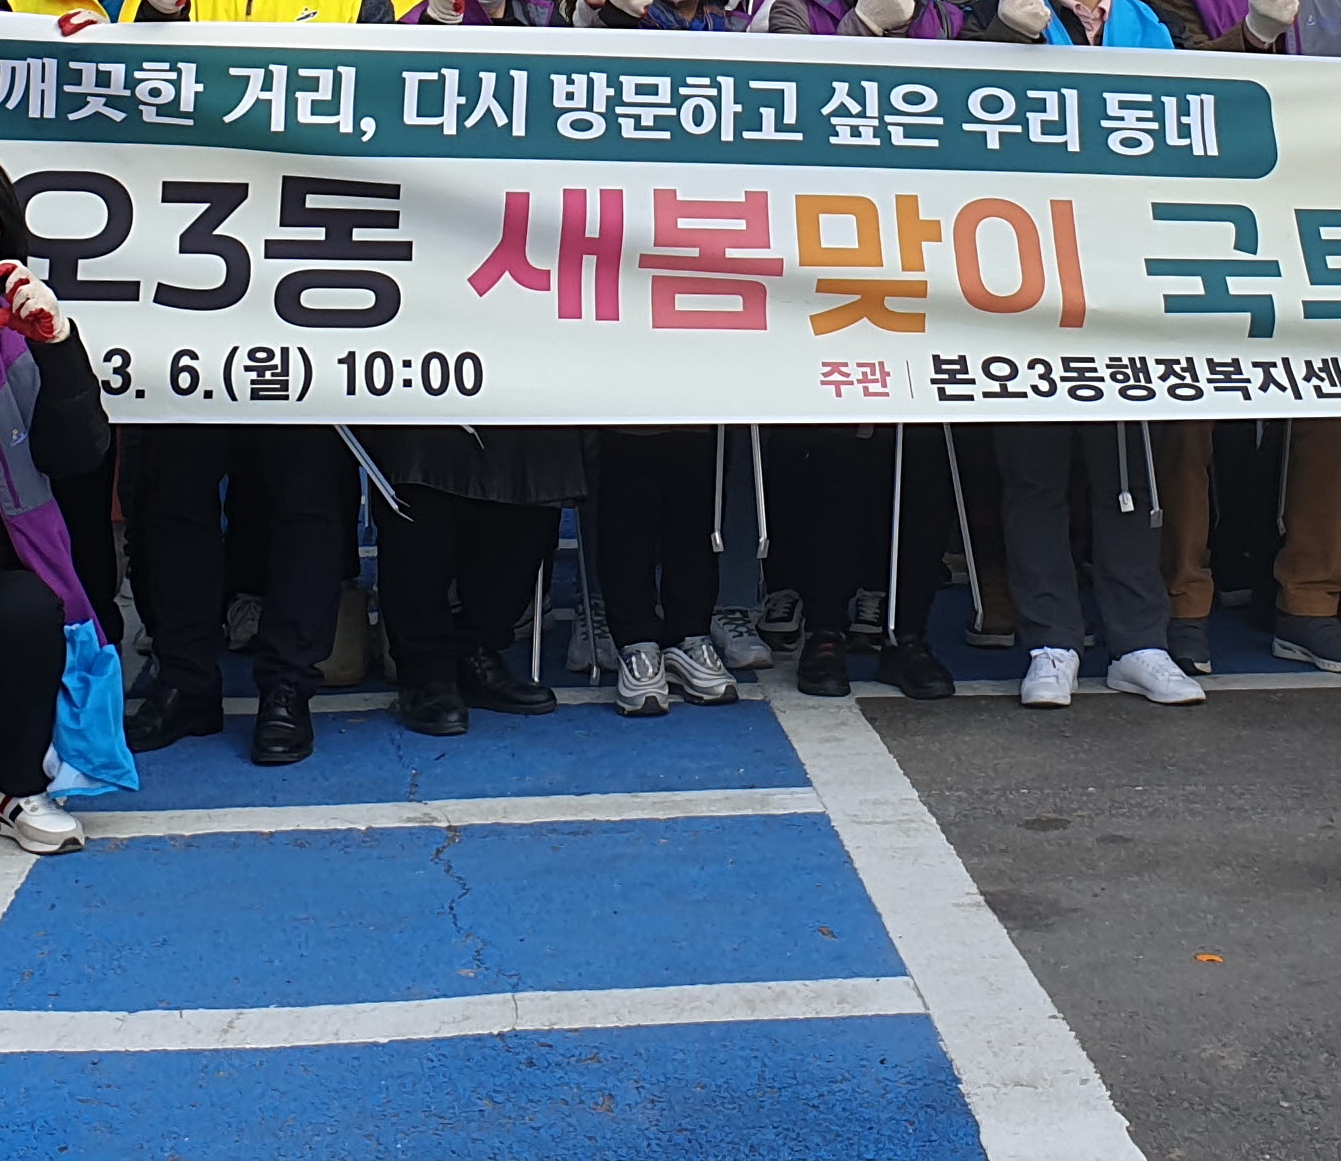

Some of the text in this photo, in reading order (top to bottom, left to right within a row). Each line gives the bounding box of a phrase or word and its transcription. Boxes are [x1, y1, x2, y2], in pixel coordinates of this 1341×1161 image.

[223, 64, 377, 141] 거리,
[402, 69, 527, 138] 다시
[553, 72, 804, 143] 방문하고
[820, 80, 945, 147] 싶은
[961, 87, 1080, 153] 우리
[1100, 91, 1219, 158] 동네
[467, 187, 1087, 337] 새봄맞이
[169, 345, 314, 402] 6.(월)
[337, 350, 483, 397] 10:00
[819, 360, 892, 399] 주관
